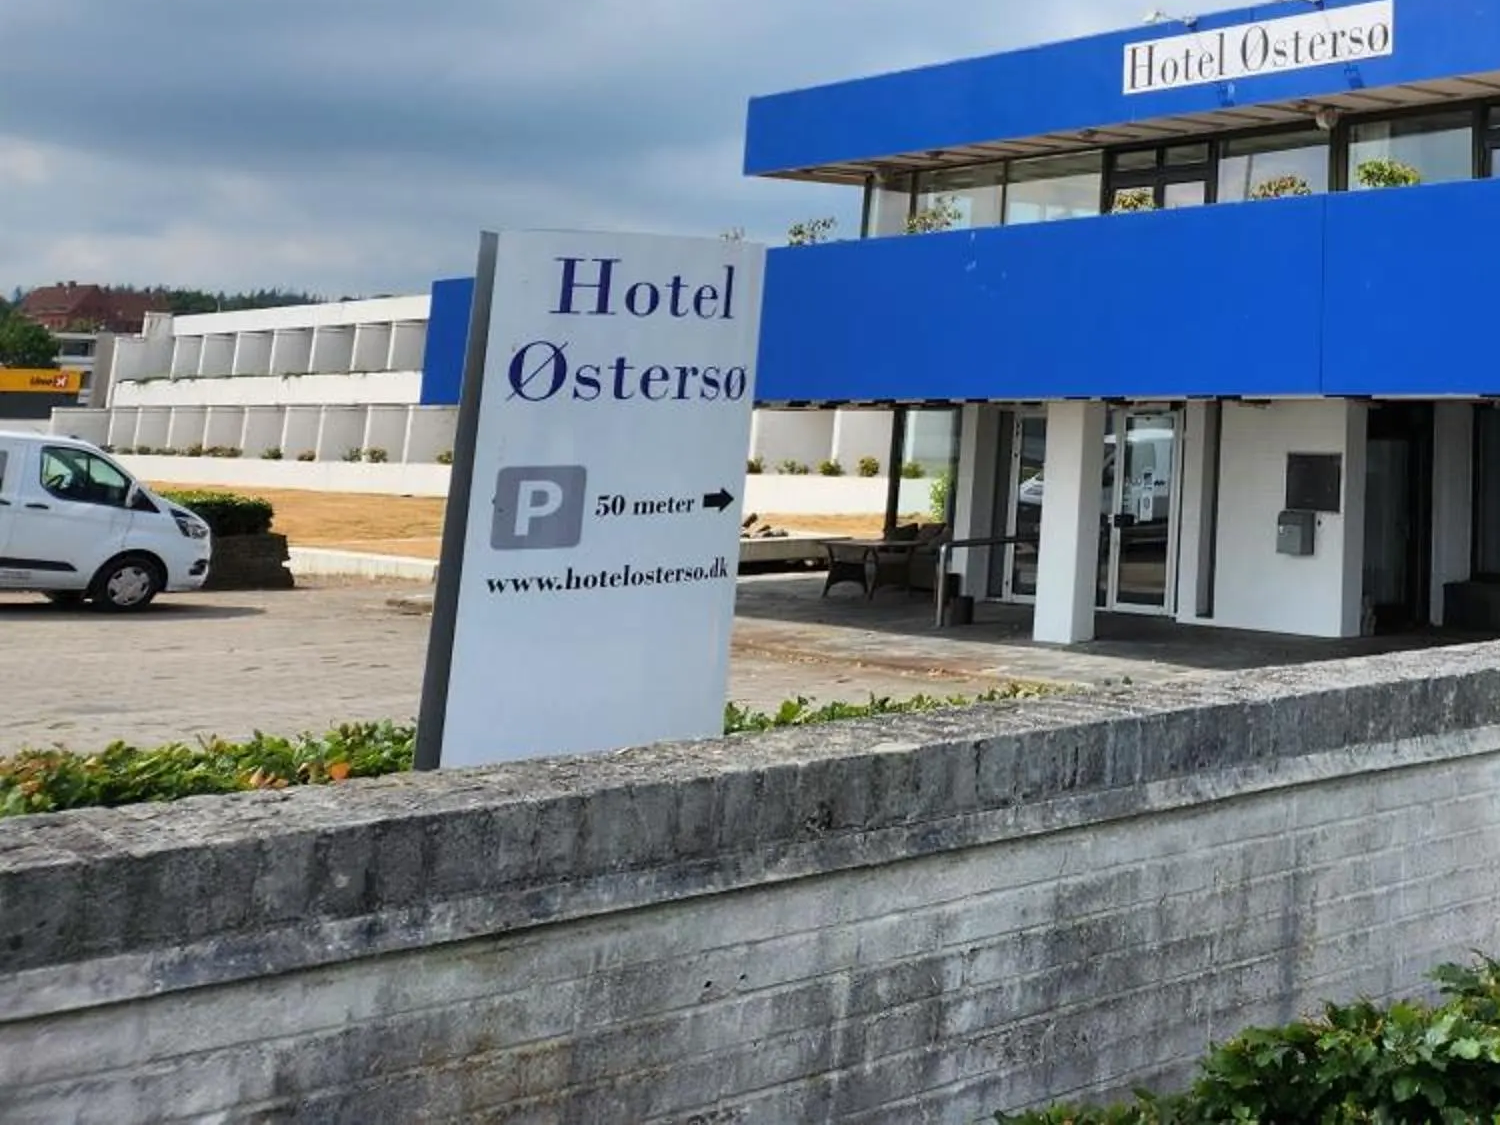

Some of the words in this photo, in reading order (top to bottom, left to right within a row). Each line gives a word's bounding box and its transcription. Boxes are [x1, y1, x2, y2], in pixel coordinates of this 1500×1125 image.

[1126, 32, 1226, 89] Hotel
[549, 257, 735, 320] Hotel
[506, 340, 747, 402] Østersø
[514, 480, 563, 537] P
[594, 494, 625, 517] 50
[632, 498, 695, 516] meter
[486, 557, 728, 594] www.hotelosterso.dk
